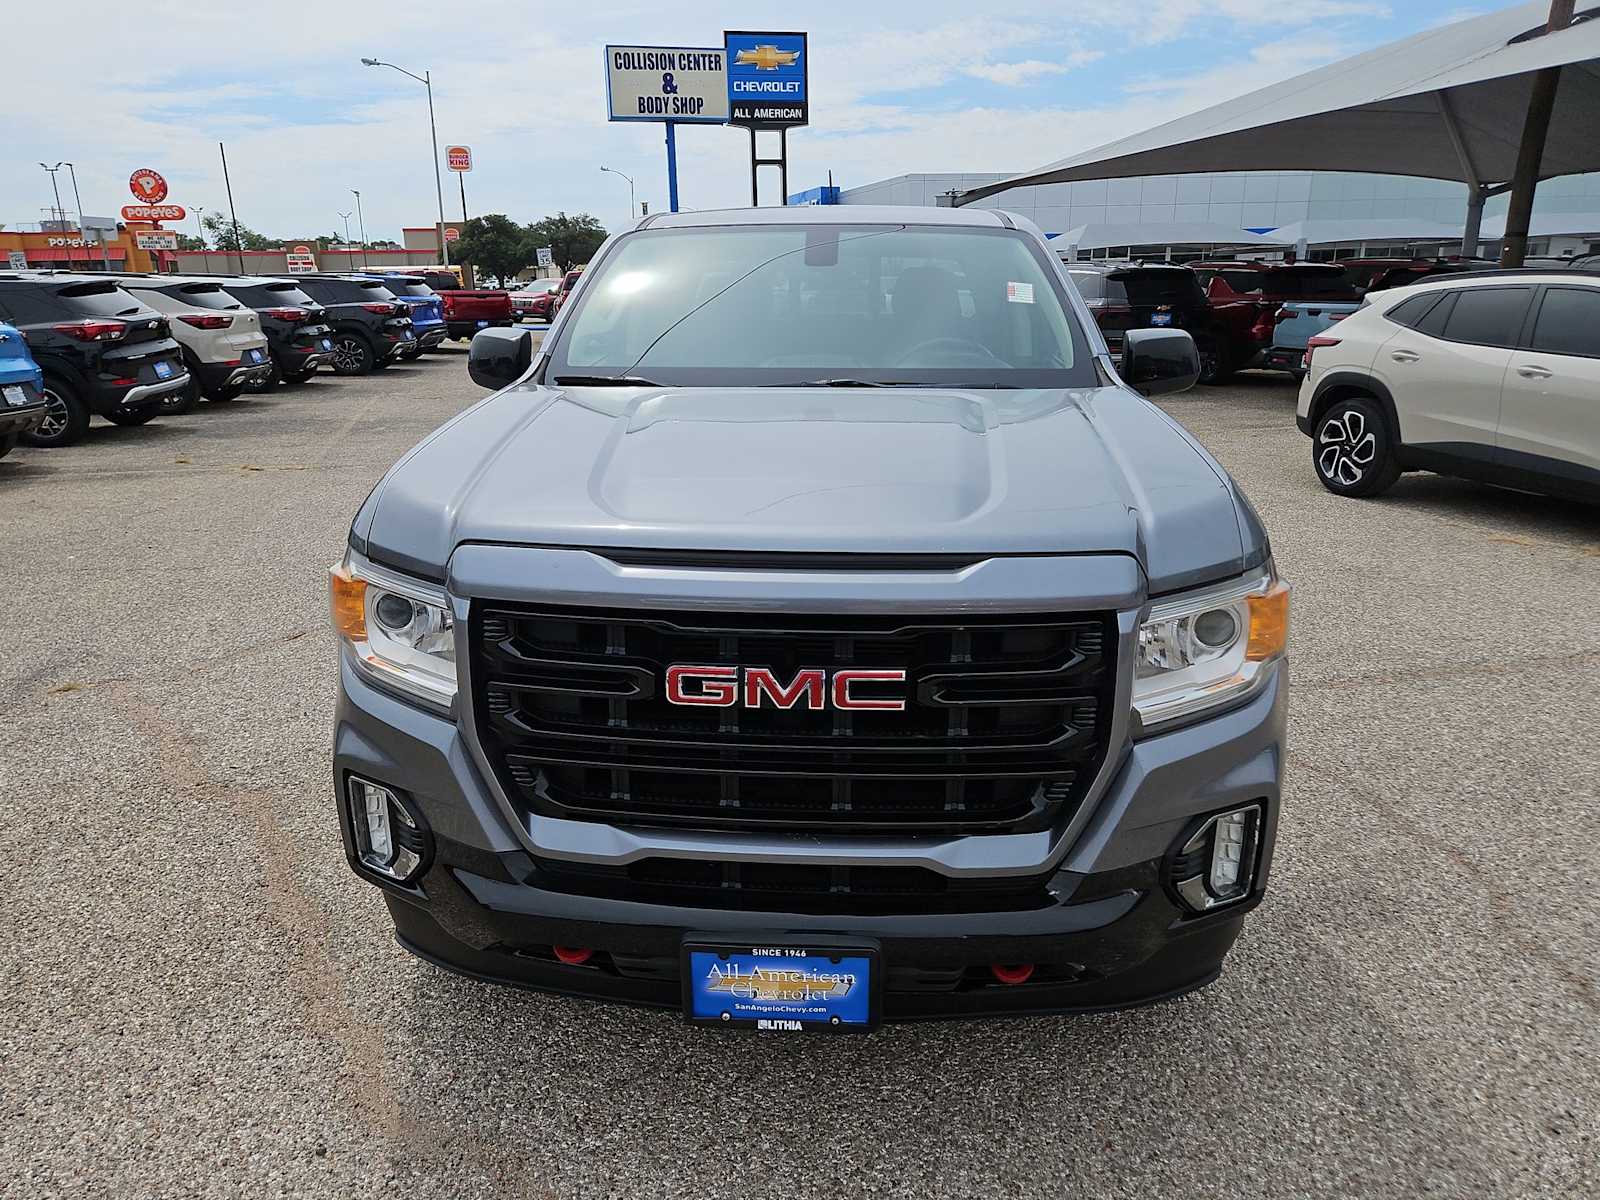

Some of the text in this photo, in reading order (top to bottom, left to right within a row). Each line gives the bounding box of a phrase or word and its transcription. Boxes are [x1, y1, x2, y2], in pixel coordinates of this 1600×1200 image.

[614, 52, 722, 71] COLLISION CENTER
[662, 72, 678, 94] &
[733, 80, 800, 93] CHEVROLET
[637, 96, 704, 114] BODY SHOP
[733, 108, 802, 119] ALL AMERICAN
[665, 664, 907, 711] GMC
[752, 948, 807, 958] SINCE 1946
[706, 963, 857, 984] All American
[730, 981, 830, 1002] Chevrolet
[735, 1003, 827, 1015] SanAngeloChevy.com
[767, 1020, 803, 1031] LITHIA
